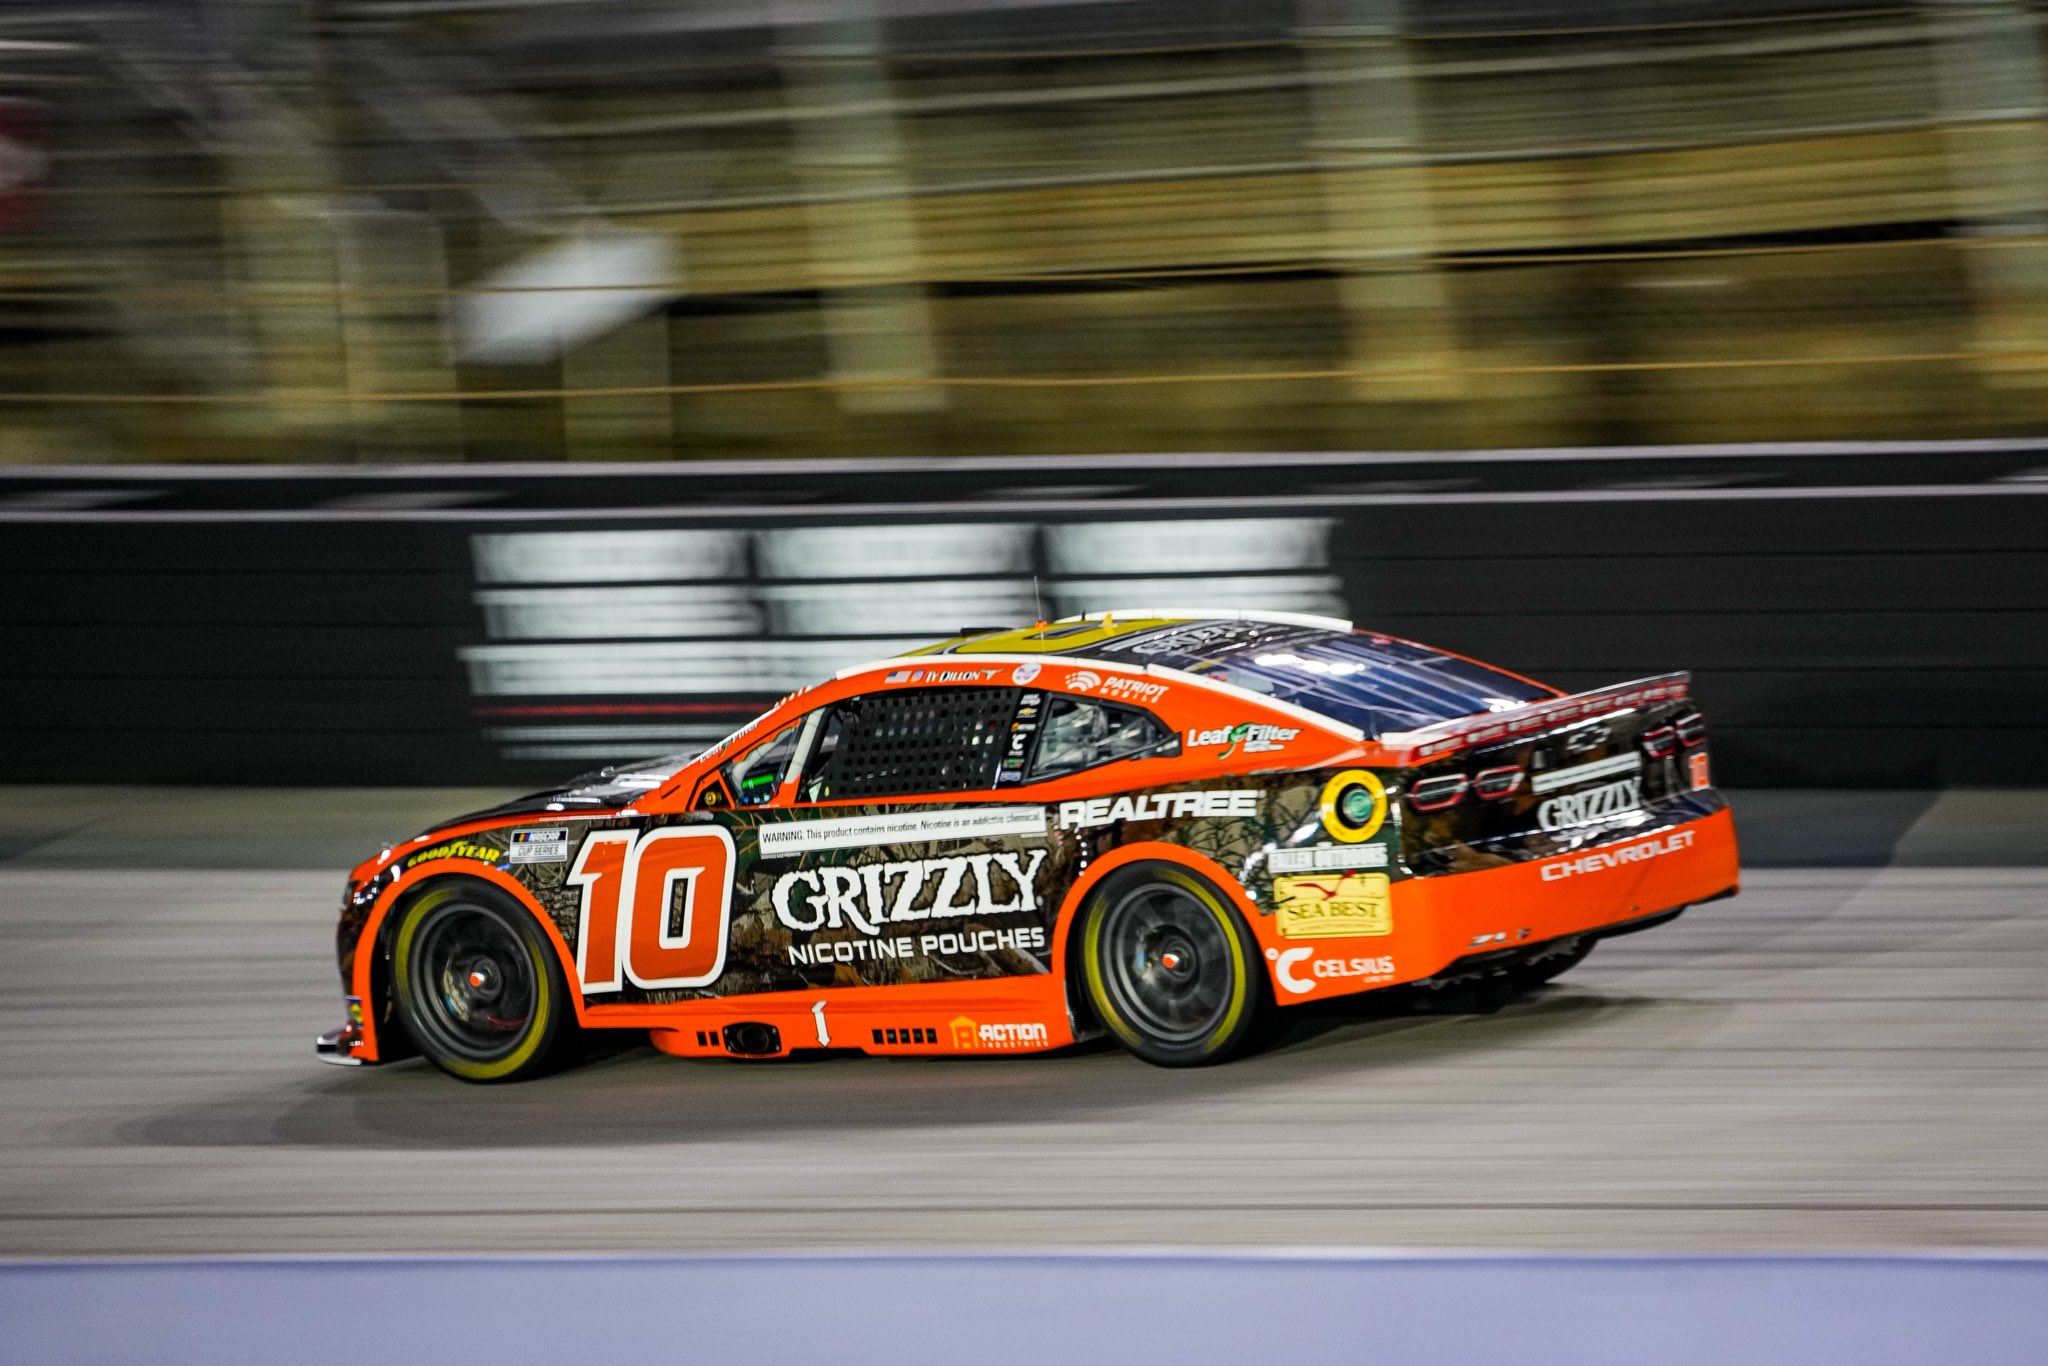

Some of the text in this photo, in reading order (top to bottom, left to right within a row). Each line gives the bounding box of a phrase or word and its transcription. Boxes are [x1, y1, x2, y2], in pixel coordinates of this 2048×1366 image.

[939, 671, 981, 683] DILLON
[1103, 676, 1170, 697] PATRIOT
[1187, 725, 1234, 748] Leaf
[1245, 723, 1302, 742] Filter
[1059, 789, 1259, 830] REALTREE
[1537, 776, 1642, 833] GRIZZLY
[806, 829, 822, 840] This
[823, 827, 852, 841] product
[853, 825, 885, 837] contains
[920, 820, 951, 831] Nicotine
[953, 818, 960, 828] is
[406, 841, 500, 868] GOODYEAR
[1540, 831, 1696, 881] CHEVROLET
[771, 848, 1048, 936] GRIZZLY
[566, 824, 738, 995] 10
[1287, 901, 1380, 921] SEA BEST
[786, 927, 1045, 966] NICOTINE POUCHES
[1313, 956, 1396, 978] CELSIUS
[979, 1023, 1048, 1041] ACTION
